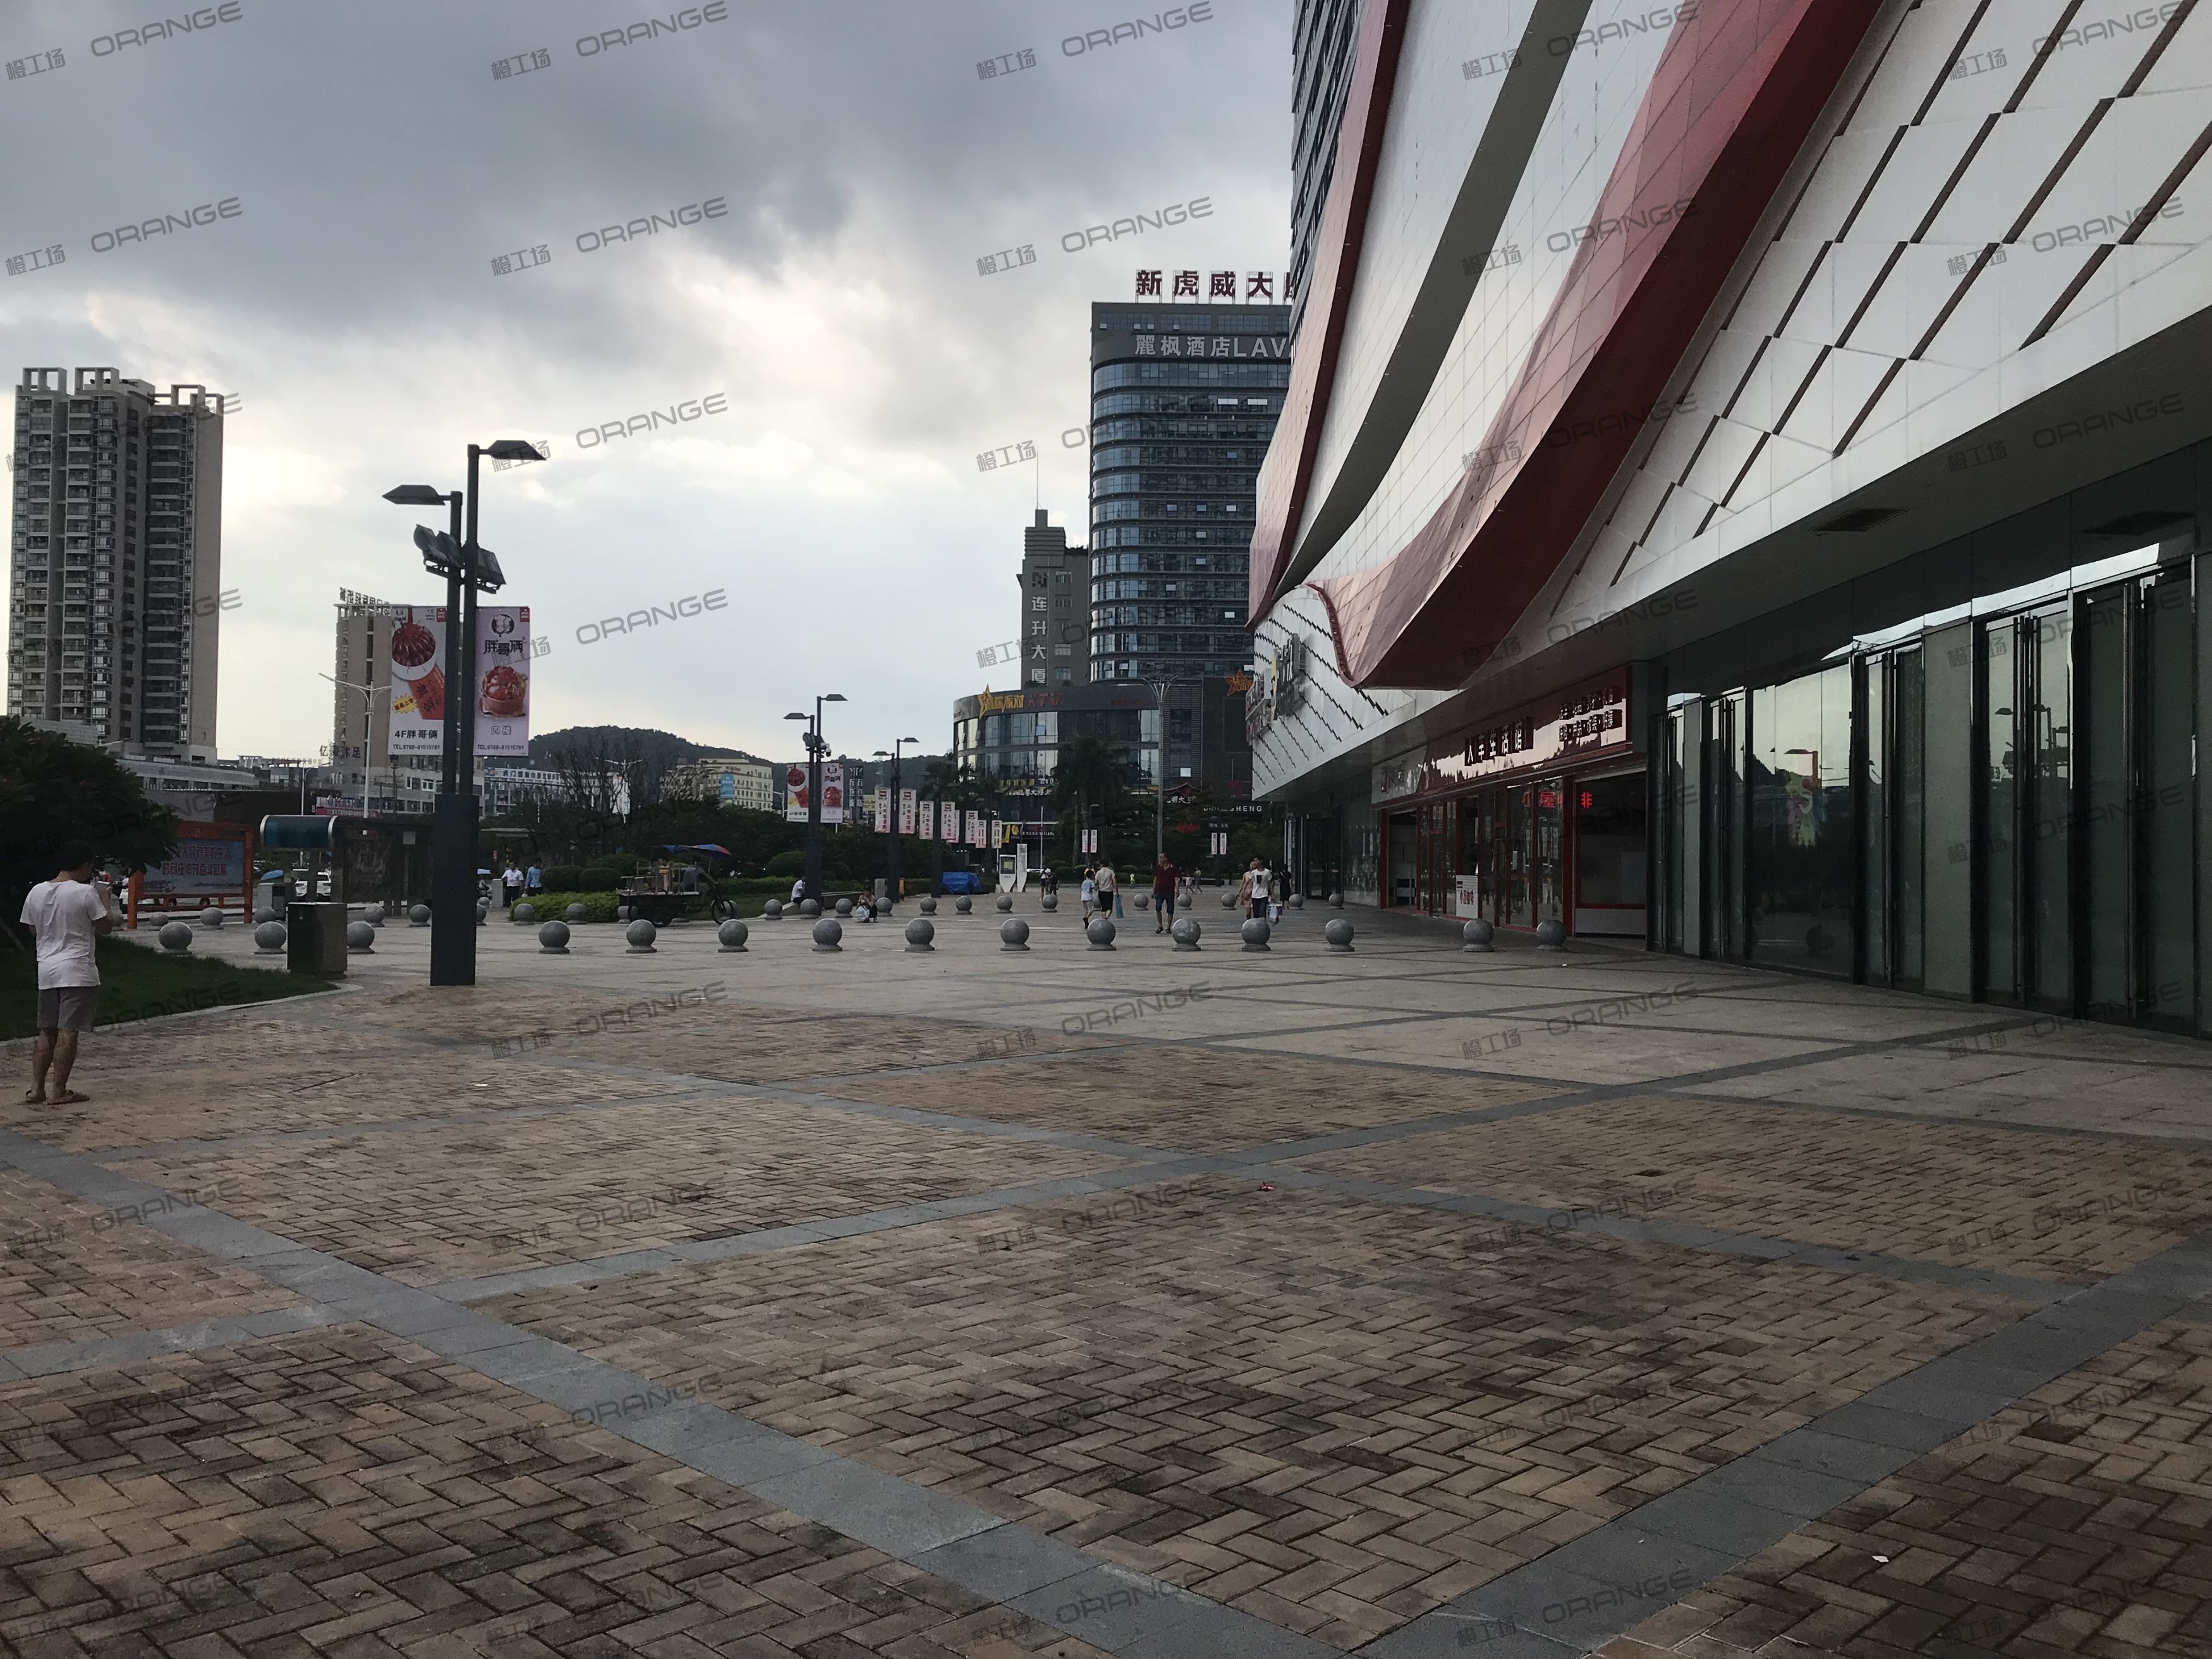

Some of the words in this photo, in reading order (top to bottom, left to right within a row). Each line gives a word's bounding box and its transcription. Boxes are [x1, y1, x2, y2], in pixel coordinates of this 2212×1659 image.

[1136, 270, 1292, 298] 新虎威大
[1234, 337, 1291, 358] LAV
[483, 639, 523, 655] 胖哥俩
[1031, 596, 1047, 684] 连升大厦
[1028, 691, 1063, 708] KTV
[394, 729, 437, 739] 4F胖哥俩
[1203, 804, 1263, 813] SHENG
